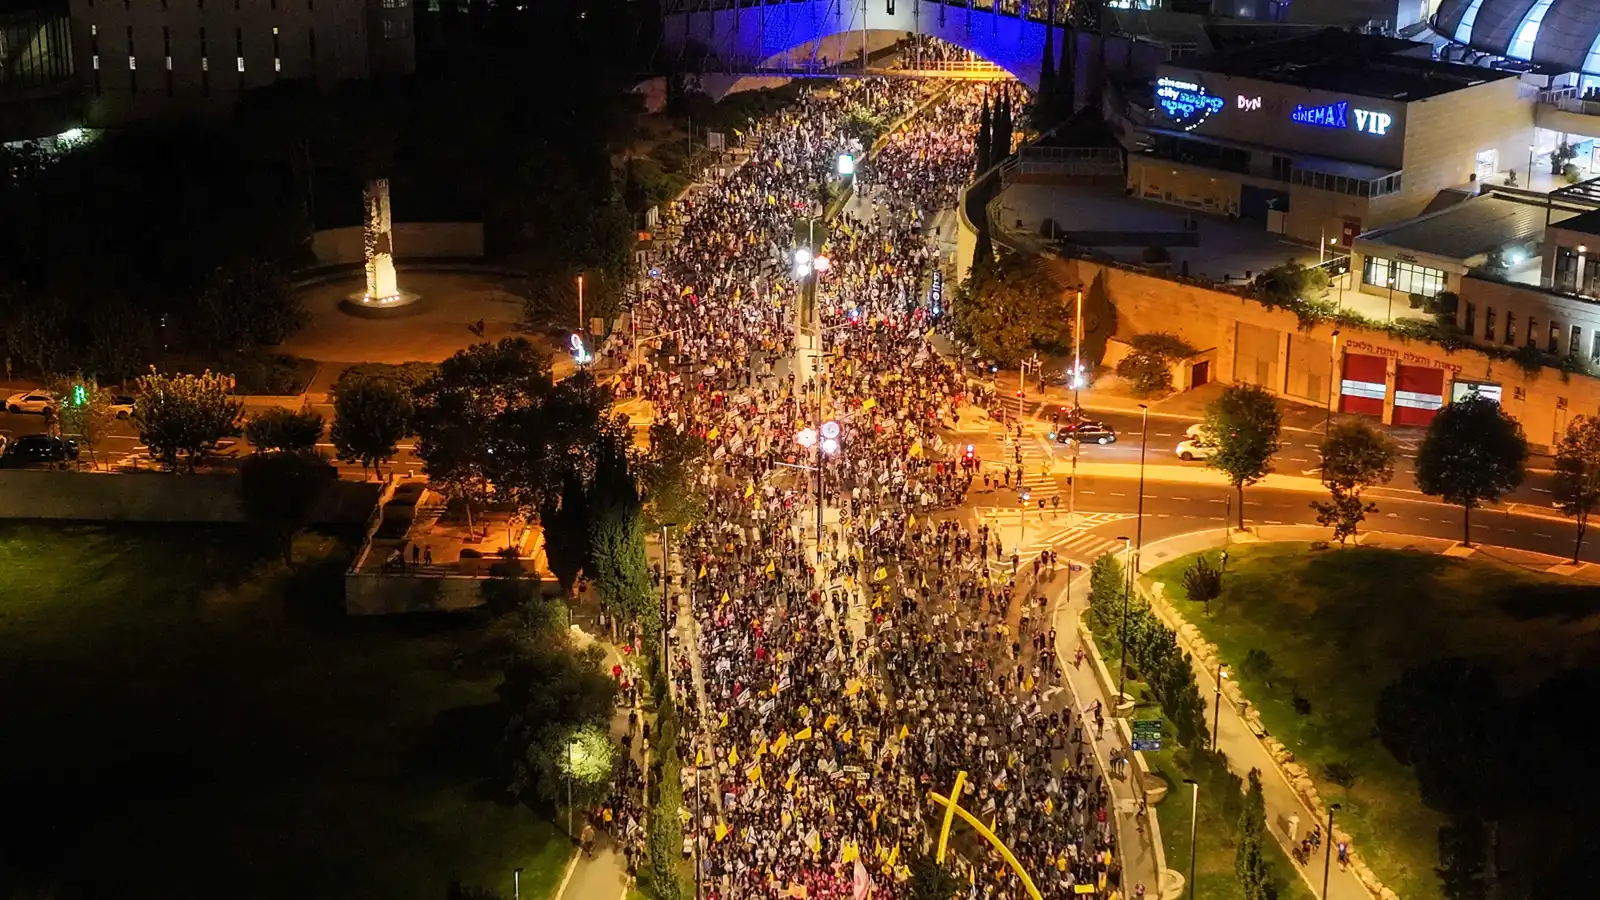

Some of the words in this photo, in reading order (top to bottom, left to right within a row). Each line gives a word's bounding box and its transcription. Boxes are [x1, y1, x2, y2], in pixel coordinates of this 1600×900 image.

[1157, 77, 1198, 91] cinema
[1157, 87, 1180, 100] city
[1353, 108, 1392, 135] VIP
[1403, 352, 1430, 366] והצלה
